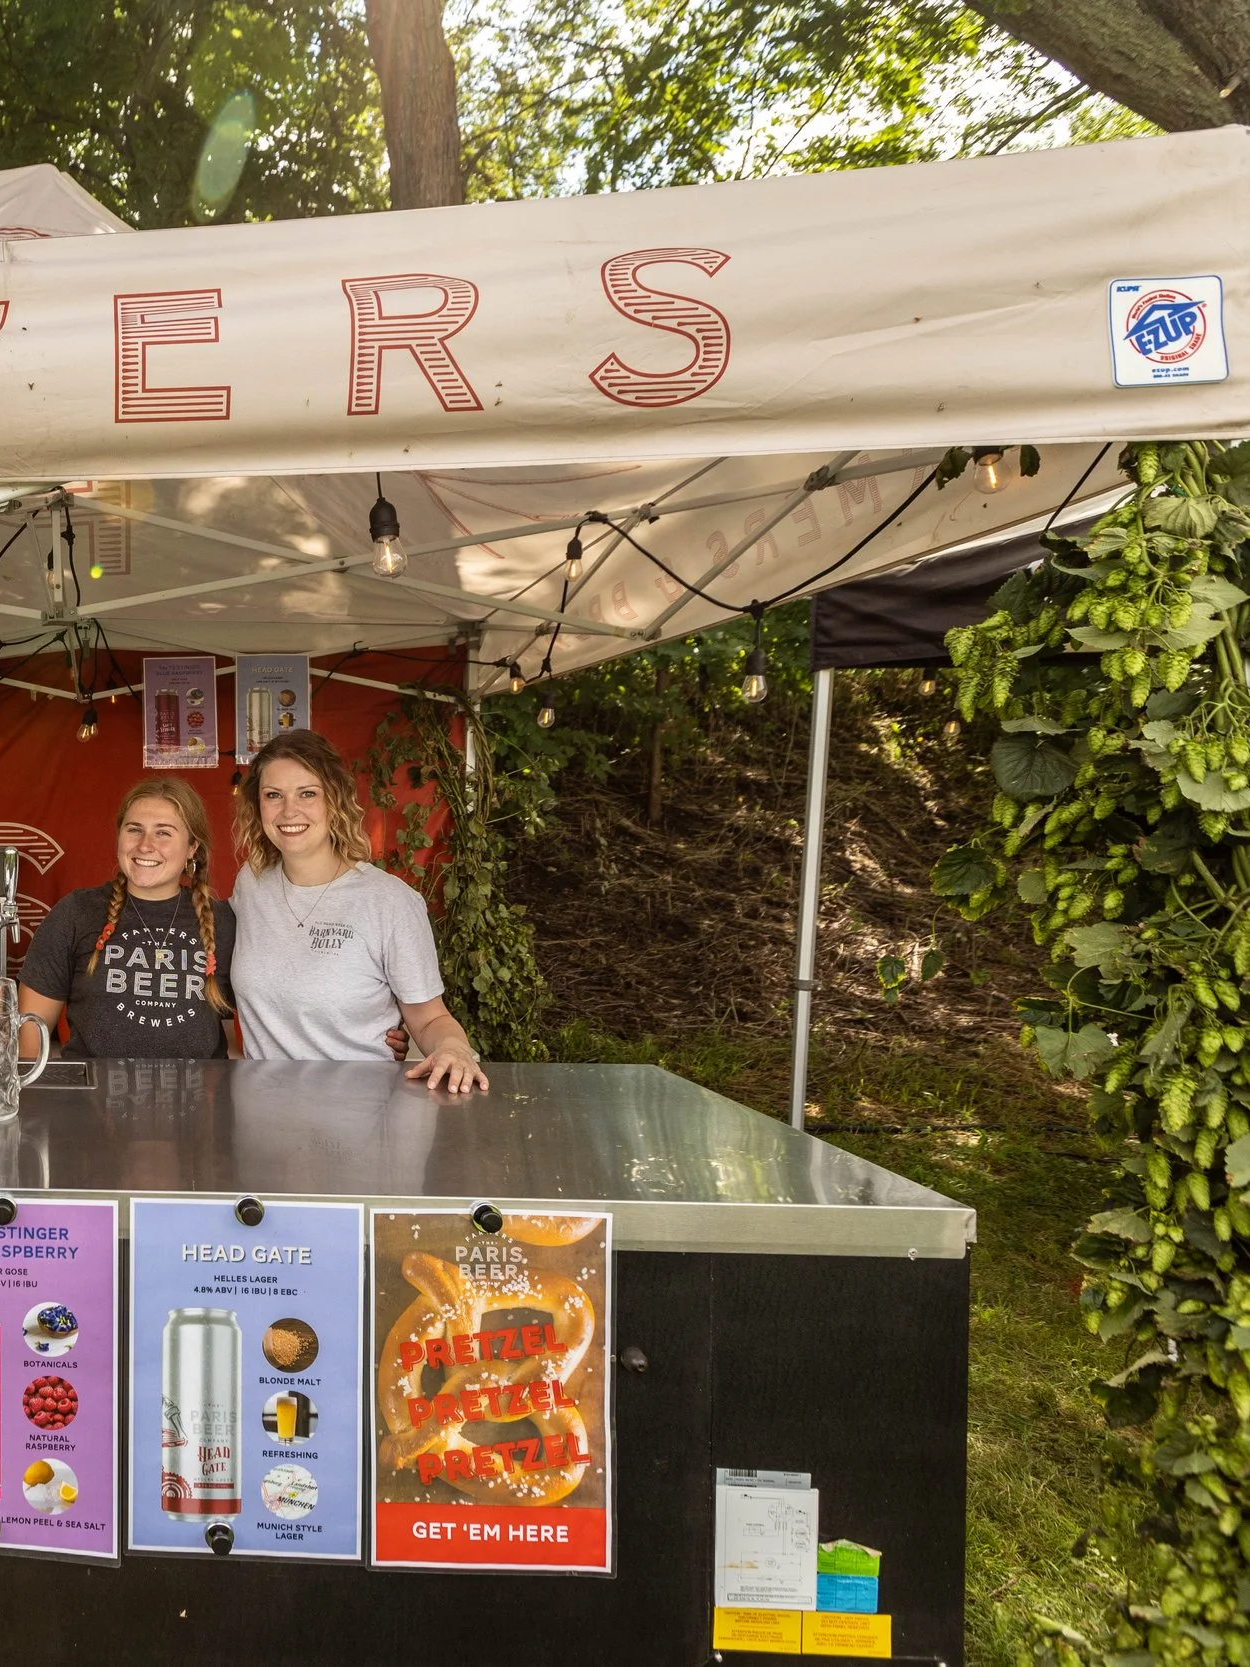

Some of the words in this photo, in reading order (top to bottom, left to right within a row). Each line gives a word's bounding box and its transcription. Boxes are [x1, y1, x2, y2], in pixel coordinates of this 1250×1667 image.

[104, 945, 208, 973] PARIS
[106, 968, 206, 1001] BEER
[135, 999, 177, 1008] COMPANY
[116, 1002, 196, 1028] BREWERS
[181, 1243, 246, 1263] HEAD
[251, 1245, 313, 1265] GATE
[455, 1246, 523, 1263] PARIS
[5, 1268, 29, 1276] GOSE
[458, 1263, 518, 1280] BEER
[23, 1280, 38, 1288] IBU
[214, 1275, 248, 1283] HELLES
[249, 1275, 278, 1284] LAGER
[193, 1286, 213, 1294] 4.8%
[215, 1286, 233, 1295] ABV
[251, 1287, 267, 1296] IBU
[273, 1288, 279, 1296] 8
[280, 1288, 298, 1296] EBC
[399, 1322, 568, 1373] PRETZEL
[23, 1360, 78, 1369] BOTANICALS
[259, 1376, 295, 1386] BLONDE
[297, 1377, 322, 1387] MALT
[406, 1378, 577, 1430] PRETZEL
[190, 1410, 238, 1423] PARIS
[192, 1423, 235, 1437] BEER
[29, 1434, 70, 1443] NATURAL
[25, 1442, 76, 1452] RASPBERRY
[198, 1445, 231, 1463] HEAD
[262, 1450, 319, 1460] REFRESHING
[416, 1432, 593, 1486] PRETZEL
[201, 1462, 227, 1476] GATE
[1, 1516, 31, 1525] LEMON
[33, 1518, 54, 1527] PEEL
[56, 1519, 63, 1527] &
[65, 1520, 83, 1529] SEA
[84, 1521, 106, 1531] SALT
[257, 1522, 293, 1532] MUNICH
[296, 1524, 323, 1533] STYLE
[275, 1532, 304, 1541] LAGER
[412, 1521, 456, 1541] GET
[508, 1525, 570, 1544] HERE
